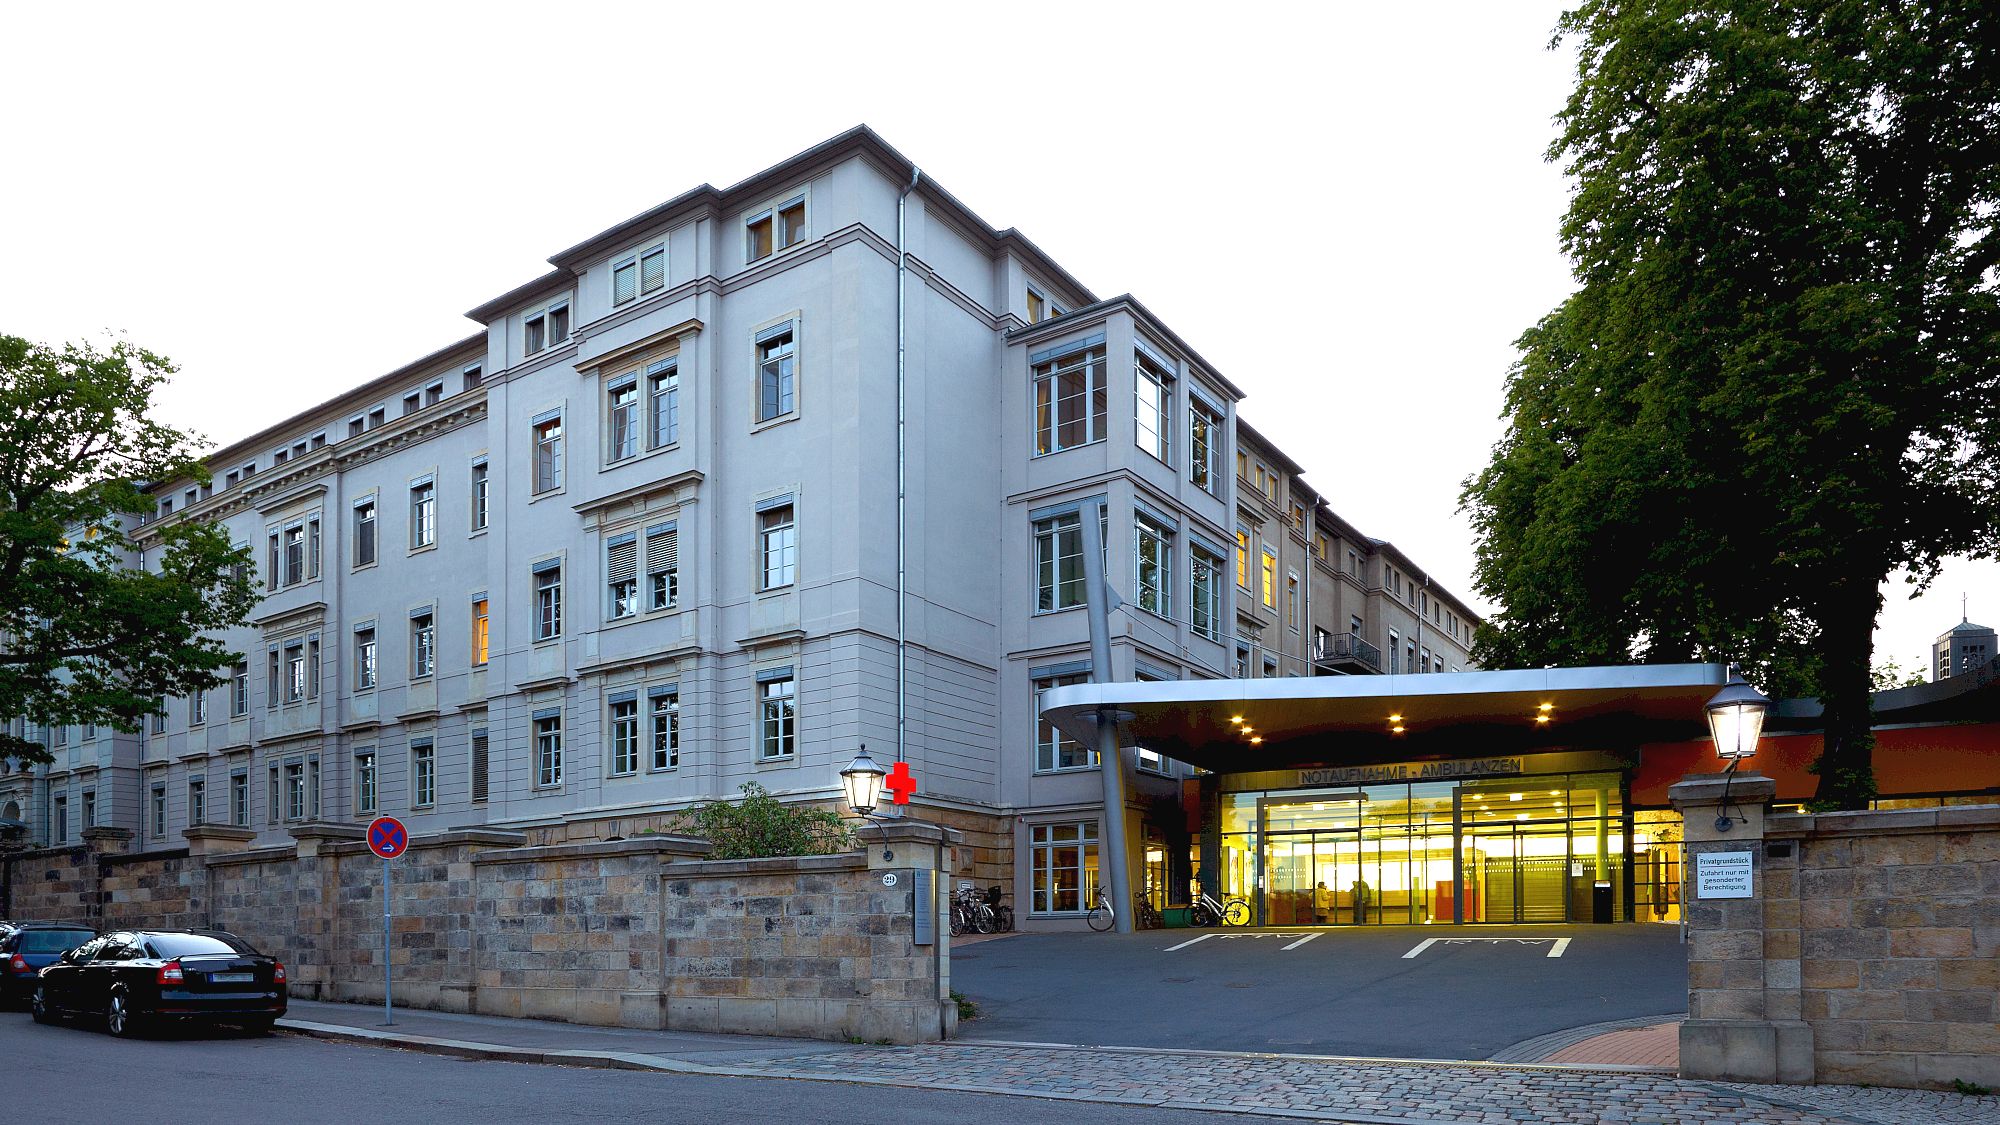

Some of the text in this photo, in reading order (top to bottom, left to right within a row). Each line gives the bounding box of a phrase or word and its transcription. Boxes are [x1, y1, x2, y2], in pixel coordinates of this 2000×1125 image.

[1301, 765, 1407, 783] NOTAUFNAHME
[1421, 758, 1520, 777] AMBULANZEN
[1700, 857, 1749, 865] Privatgrundstück
[884, 876, 895, 884] 29
